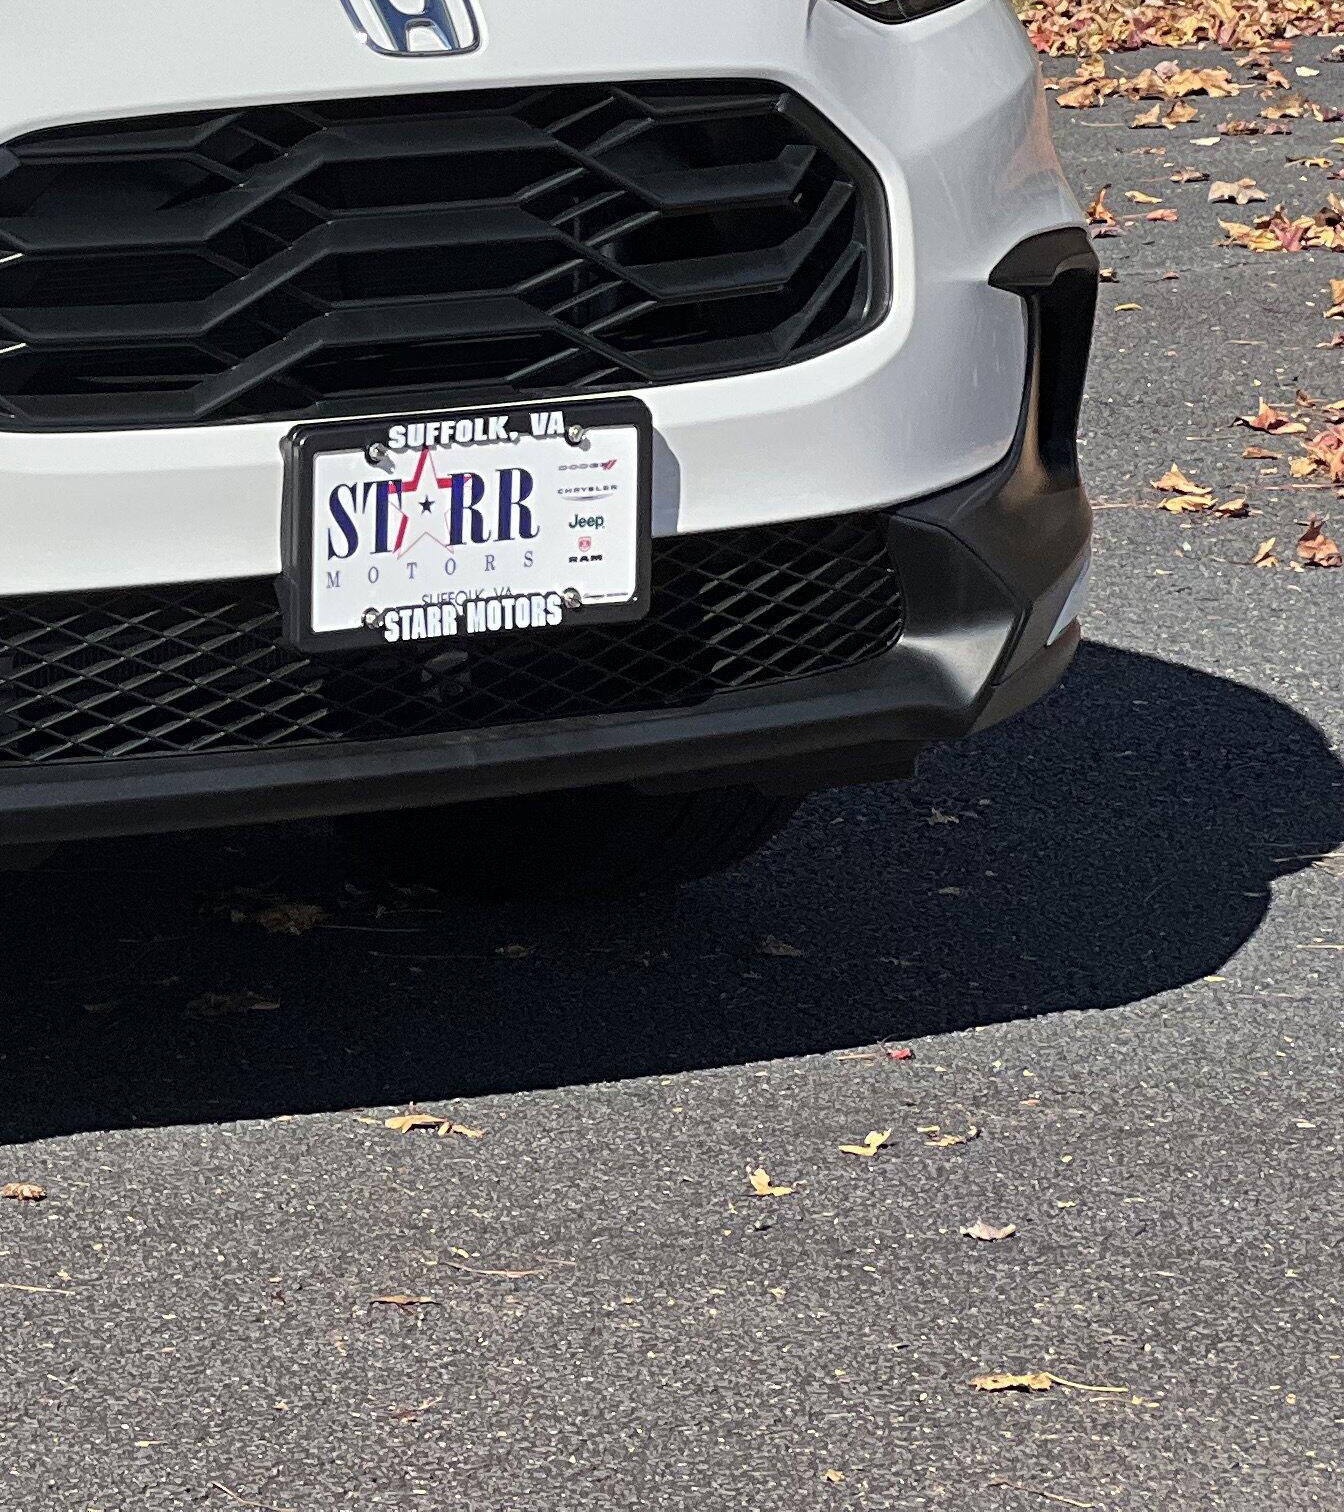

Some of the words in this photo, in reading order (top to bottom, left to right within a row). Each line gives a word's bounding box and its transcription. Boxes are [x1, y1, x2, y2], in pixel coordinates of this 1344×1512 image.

[388, 416, 519, 448] SUFFOLK,
[529, 411, 565, 436] VA
[557, 484, 618, 494] CHRYSLER
[568, 513, 605, 530] Jeep
[327, 551, 533, 589] MOTORS
[569, 554, 603, 563] RAM
[384, 604, 458, 643] STARR
[466, 594, 562, 634] MOTORS
